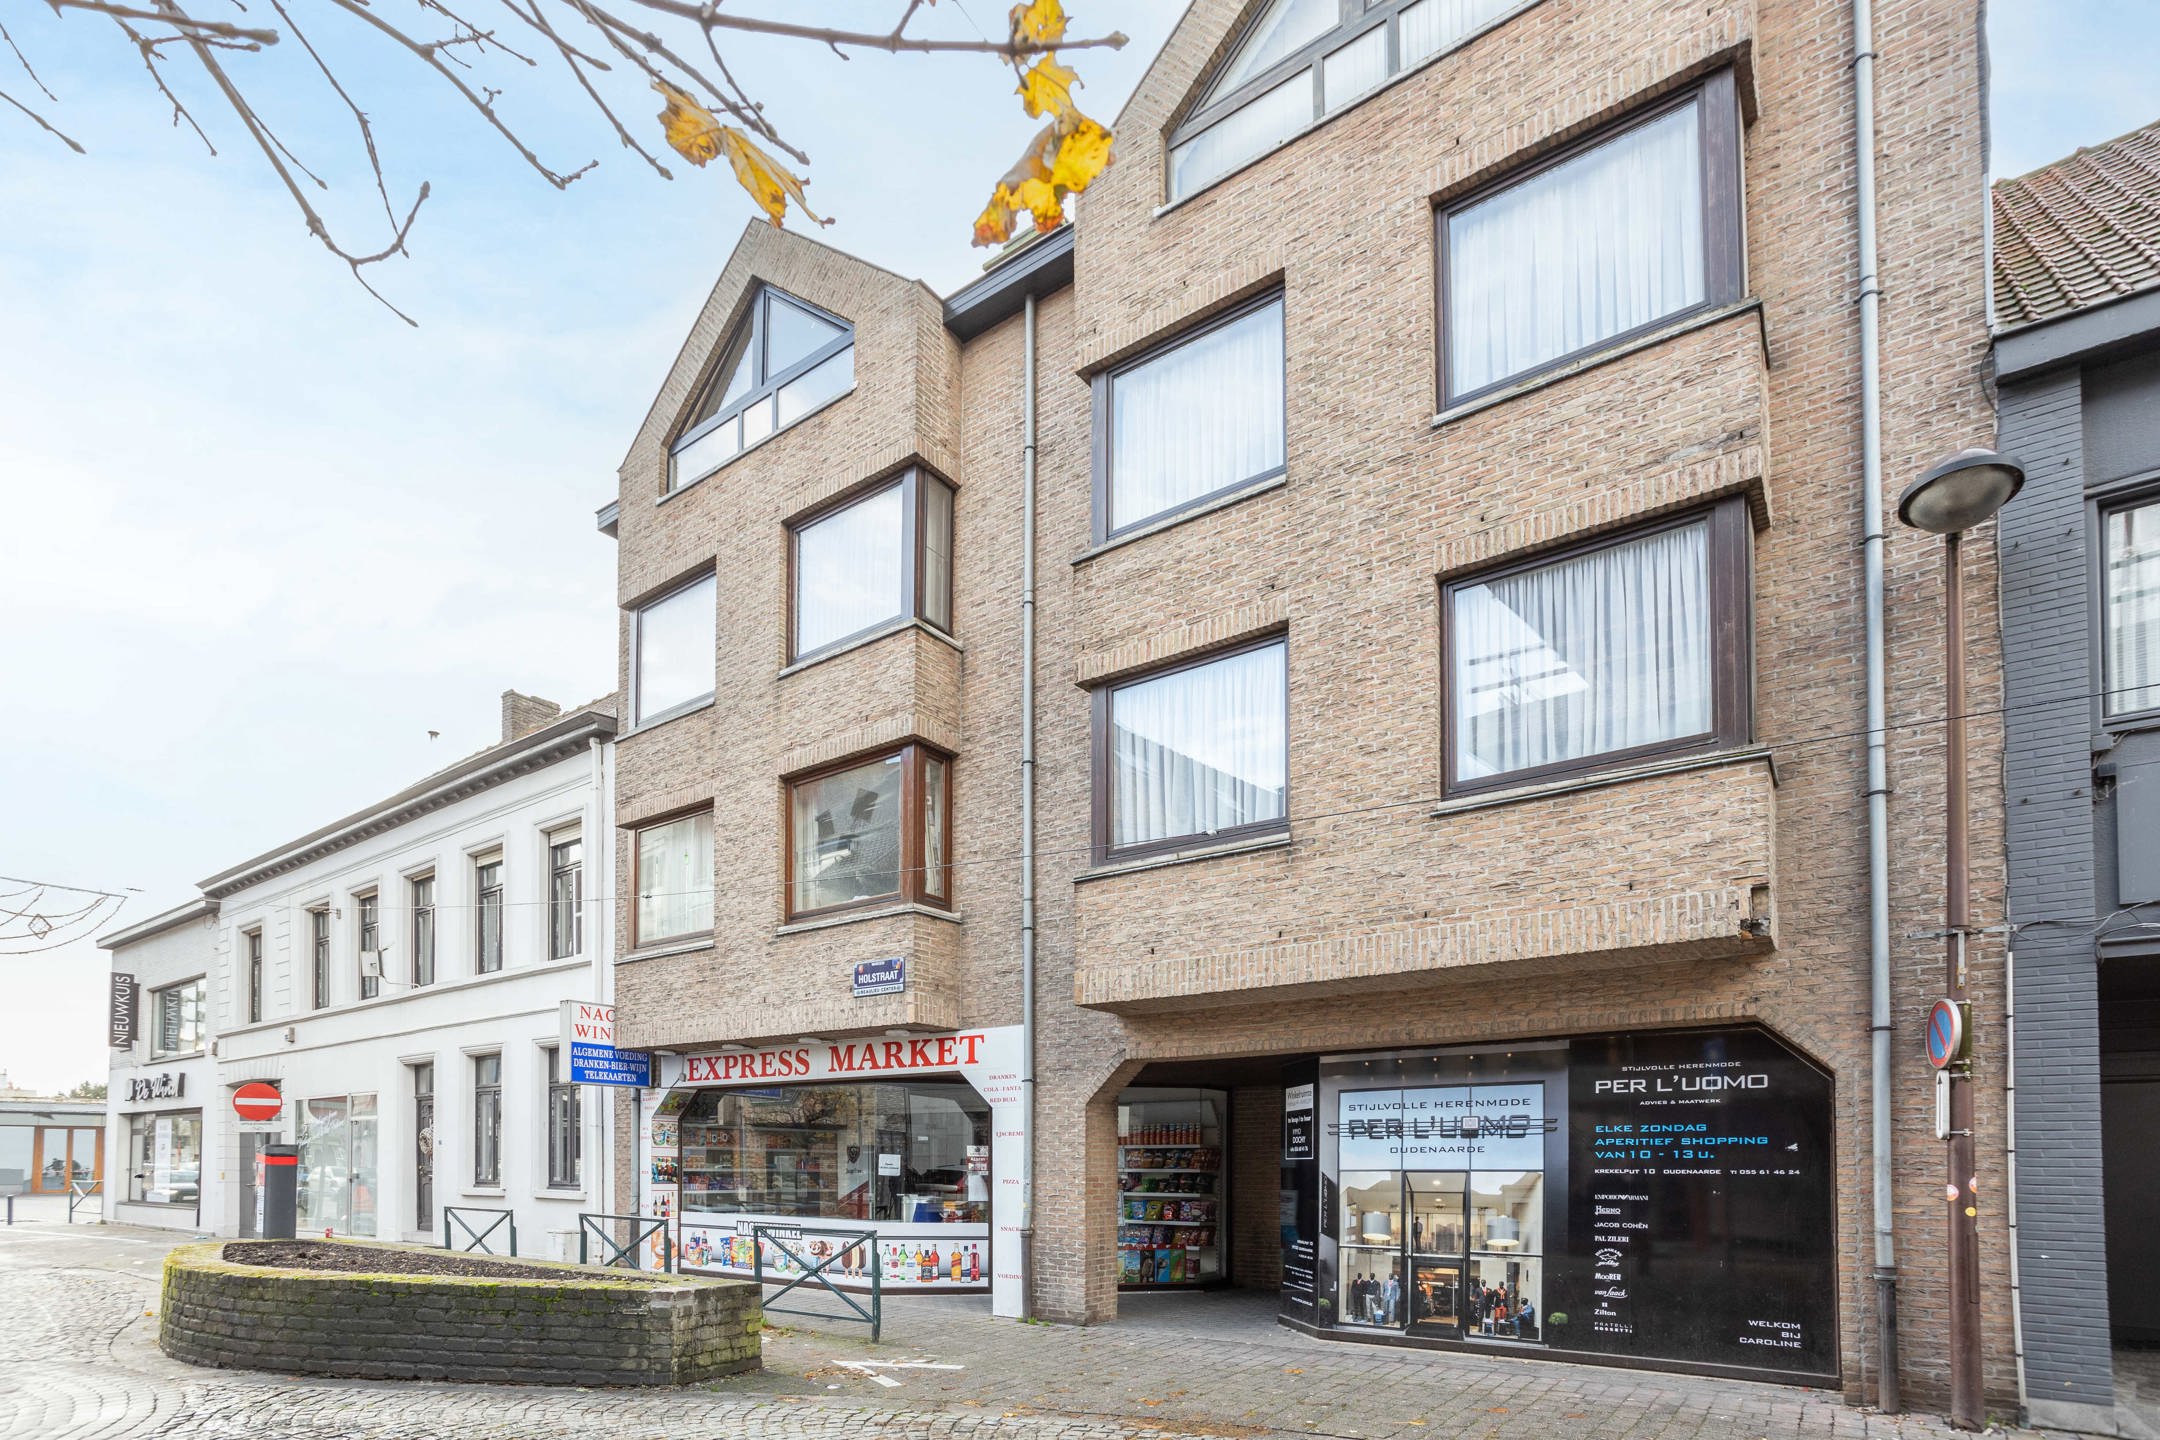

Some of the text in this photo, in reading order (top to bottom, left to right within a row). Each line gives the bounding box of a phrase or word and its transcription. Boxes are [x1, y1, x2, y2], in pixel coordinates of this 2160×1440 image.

[858, 970, 899, 984] HOLSTRAAT
[113, 976, 131, 1045] NIEUWKUIS
[575, 1023, 614, 1040] WIN
[572, 1047, 648, 1062] ALGEMENE VOEDING
[687, 1034, 985, 1082] EXPRESS MARKET
[1622, 1062, 1742, 1072] STIJLVOLLE HERENMODE
[584, 1070, 637, 1082] TELEKAARTEN
[1595, 1074, 1769, 1094] PER L'UOMO
[1348, 1098, 1532, 1112] STIJLVOLLE HERENMODE
[1349, 1119, 1402, 1138] PER
[1596, 1124, 1707, 1133] ELKE ZONDAG
[1594, 1136, 1768, 1146] APERITIEF SHOPPING
[1390, 1146, 1486, 1154] OUDENAARDE
[1595, 1151, 1625, 1159] VAN
[1630, 1150, 1651, 1159] 10
[1748, 1320, 1801, 1330] WELKOM
[1740, 1337, 1802, 1348] CAROLINE
